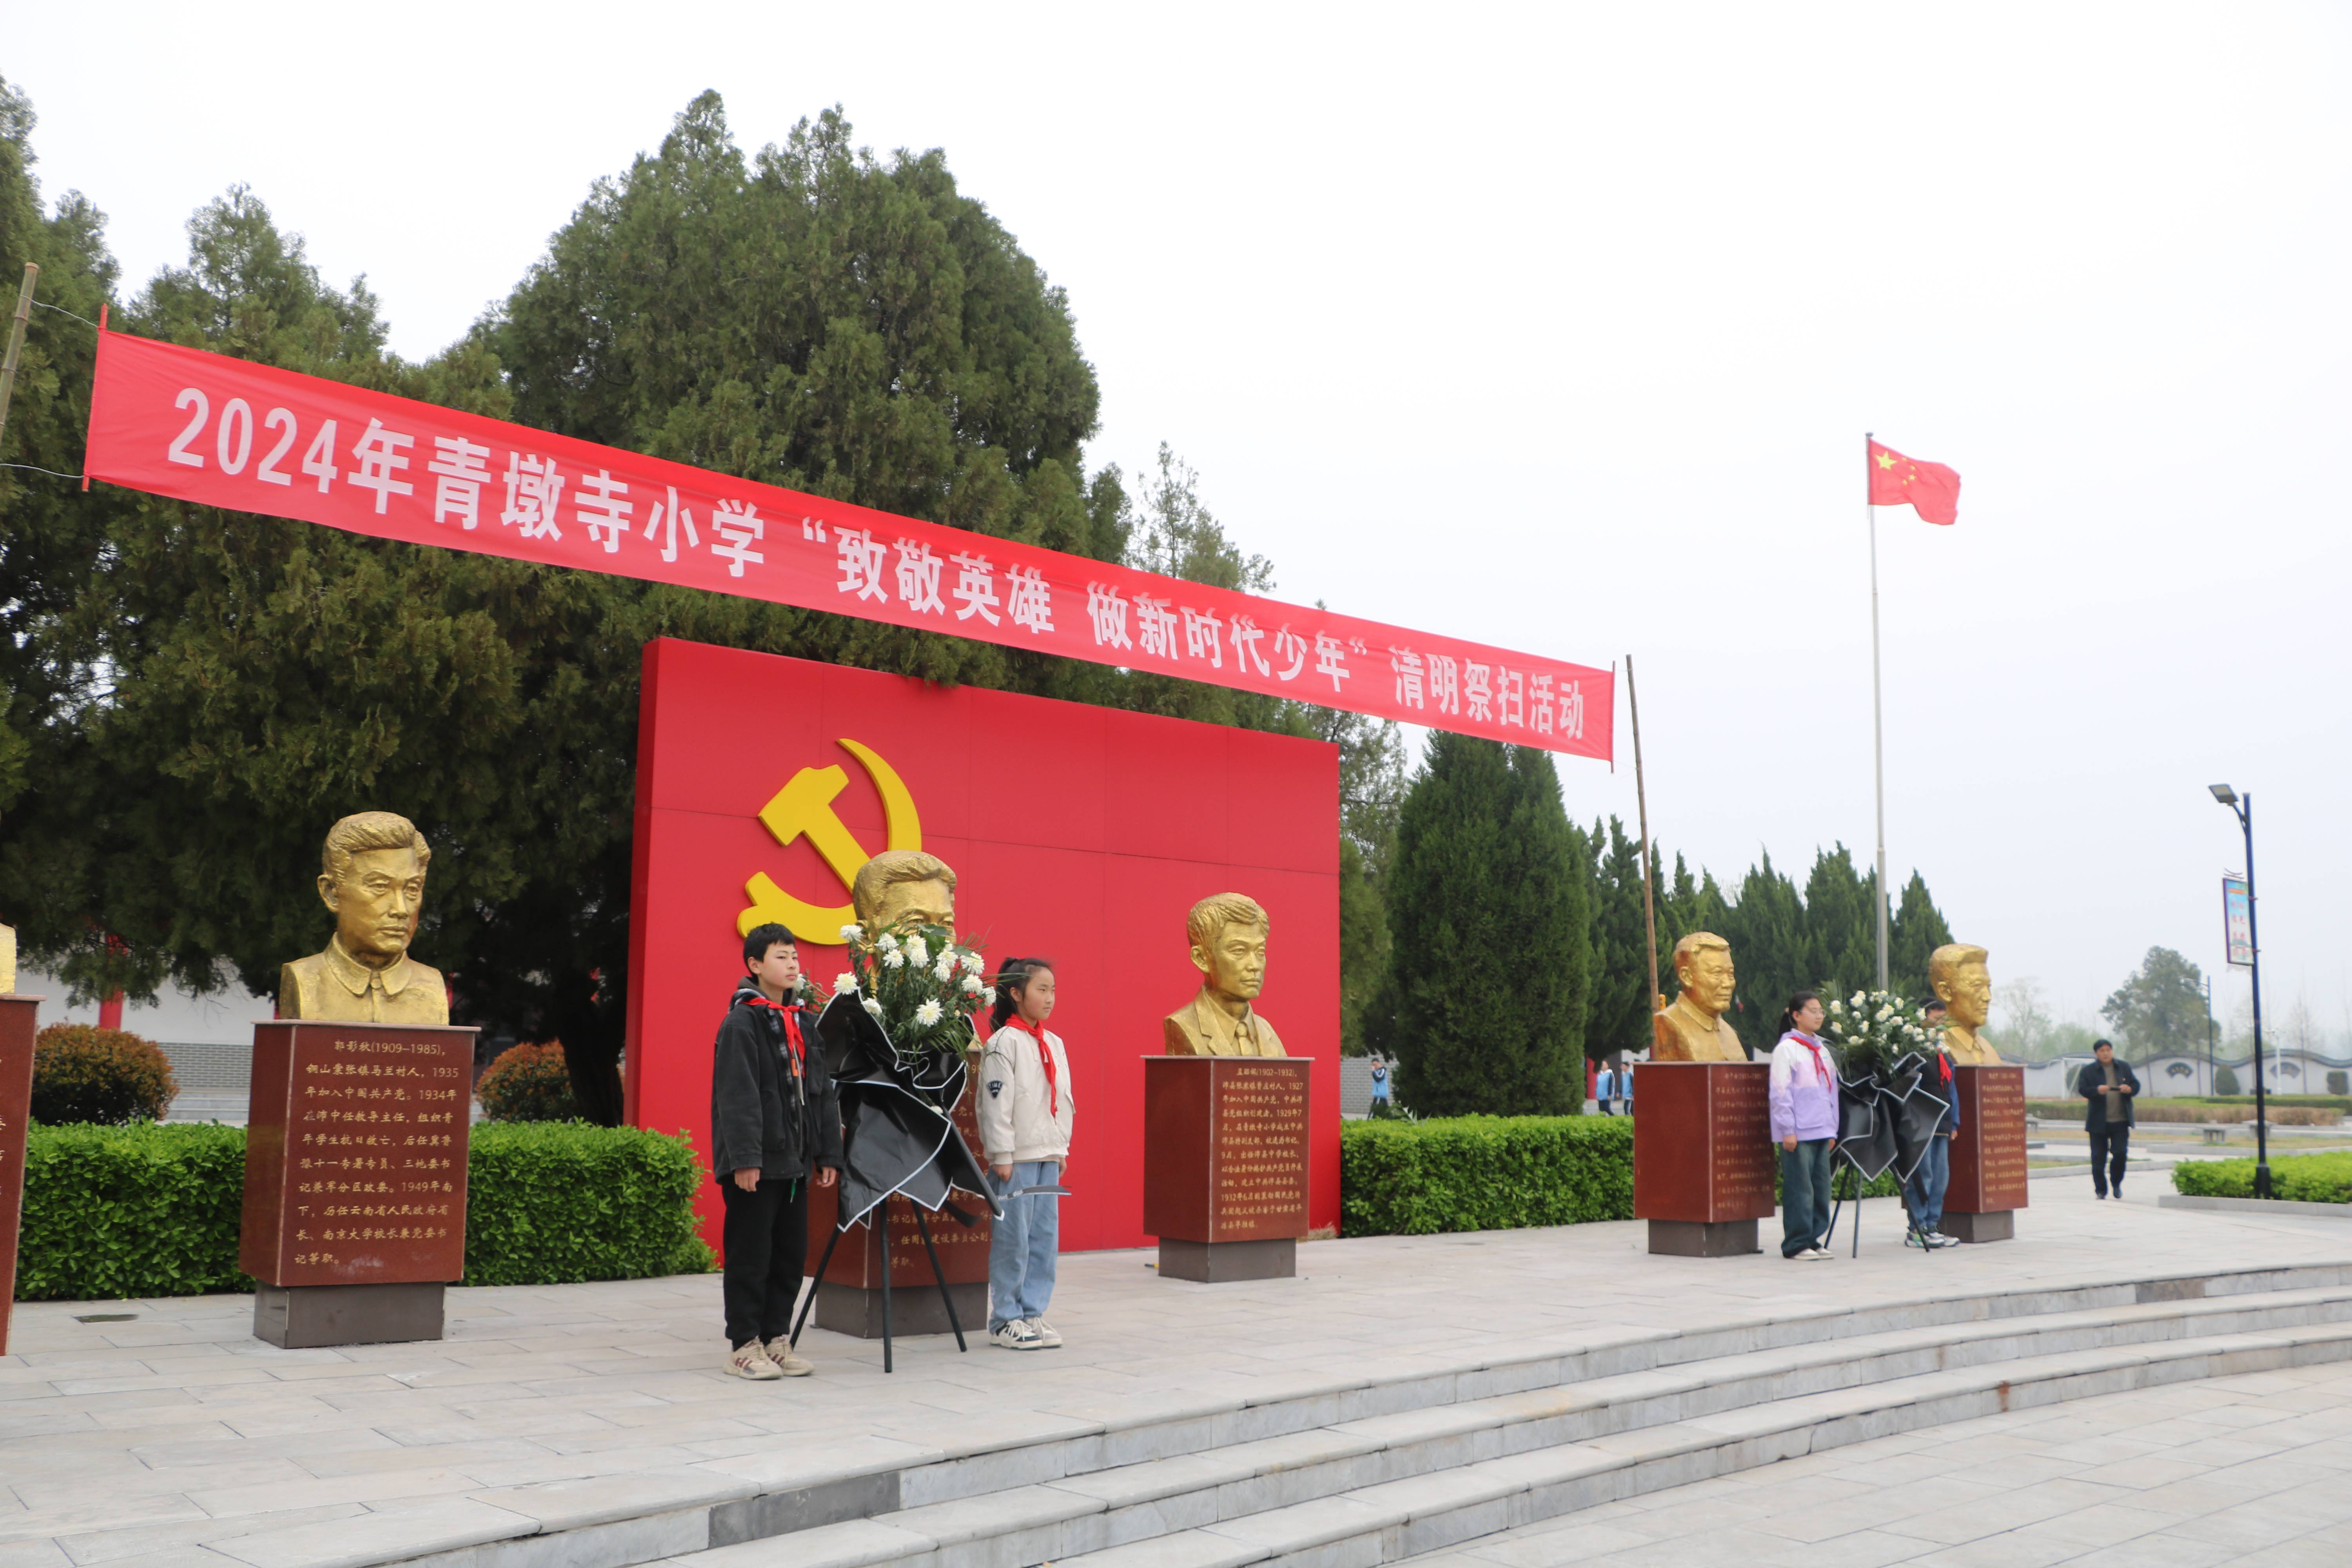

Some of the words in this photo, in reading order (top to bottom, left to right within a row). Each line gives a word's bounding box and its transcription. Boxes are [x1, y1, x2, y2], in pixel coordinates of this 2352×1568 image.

[169, 387, 764, 578] 2024年青墩寺小学
[1392, 644, 1584, 739] 清明祭扫活动
[295, 1252, 339, 1265] 记等职。
